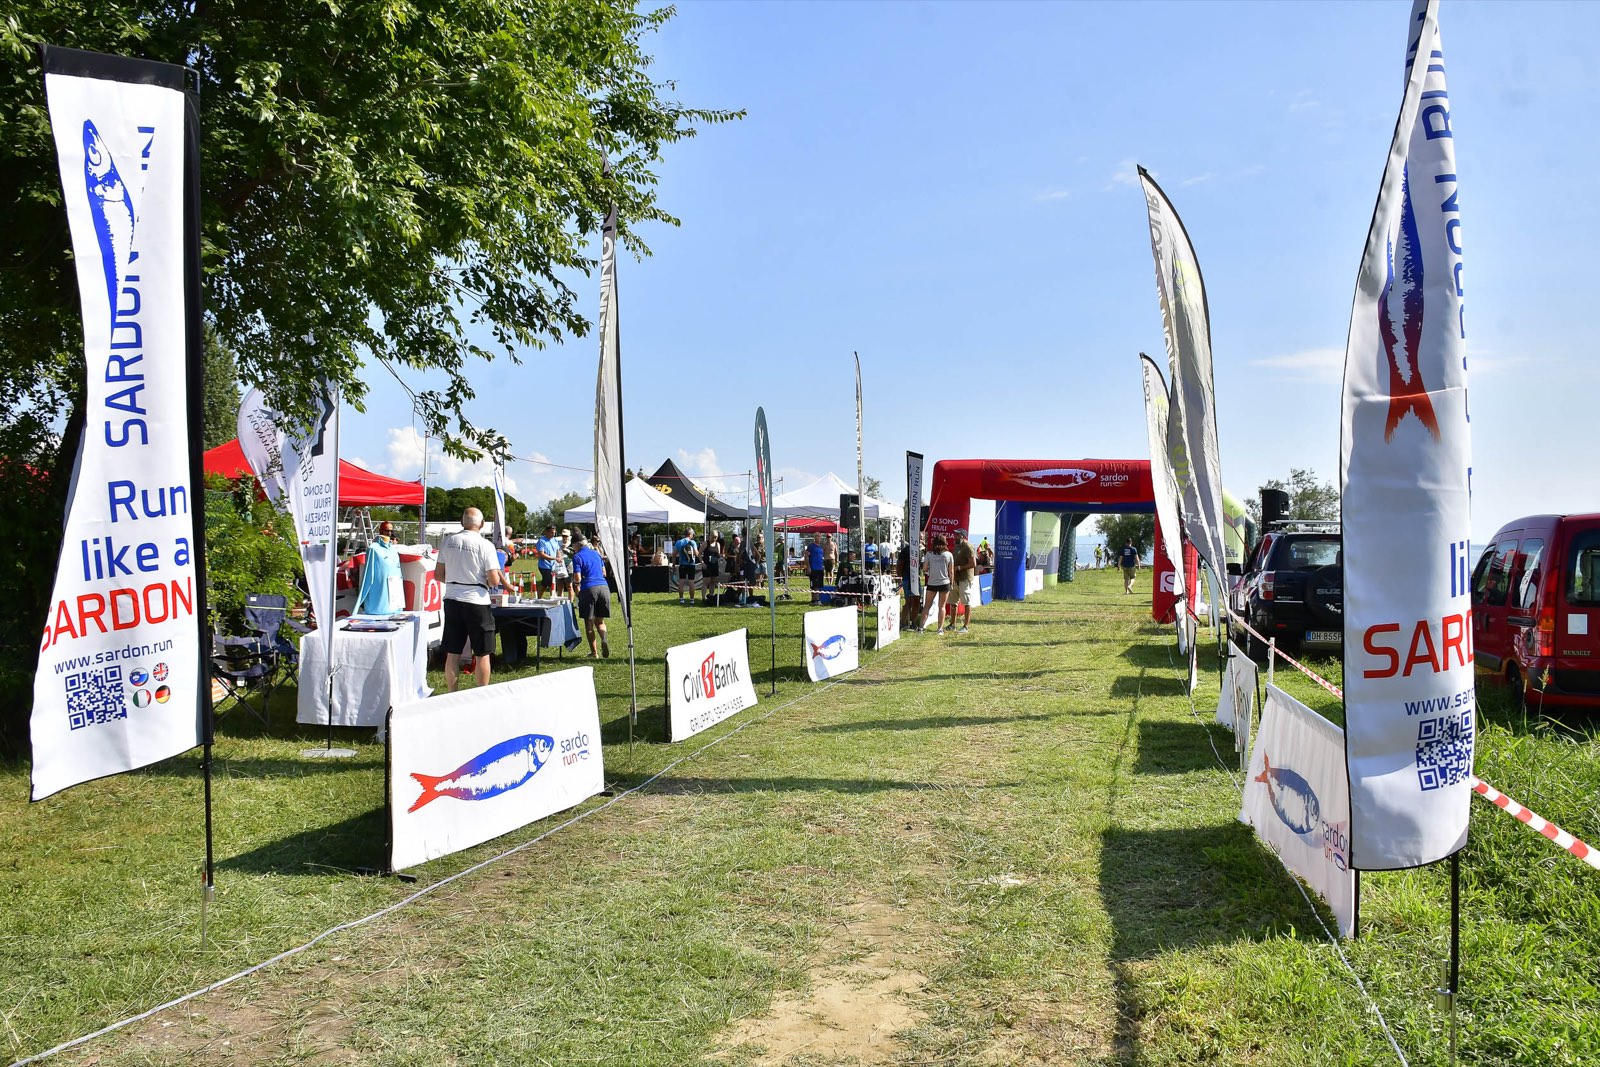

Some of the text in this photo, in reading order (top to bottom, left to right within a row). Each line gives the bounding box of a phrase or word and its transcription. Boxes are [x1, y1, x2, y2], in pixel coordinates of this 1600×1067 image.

[1100, 473, 1129, 481] sardon
[107, 479, 187, 523] Run
[931, 524, 947, 532] FRIULI
[939, 518, 959, 526] SONO
[81, 535, 190, 581] like a
[54, 638, 173, 675] www.sardon.run
[562, 753, 578, 767] run
